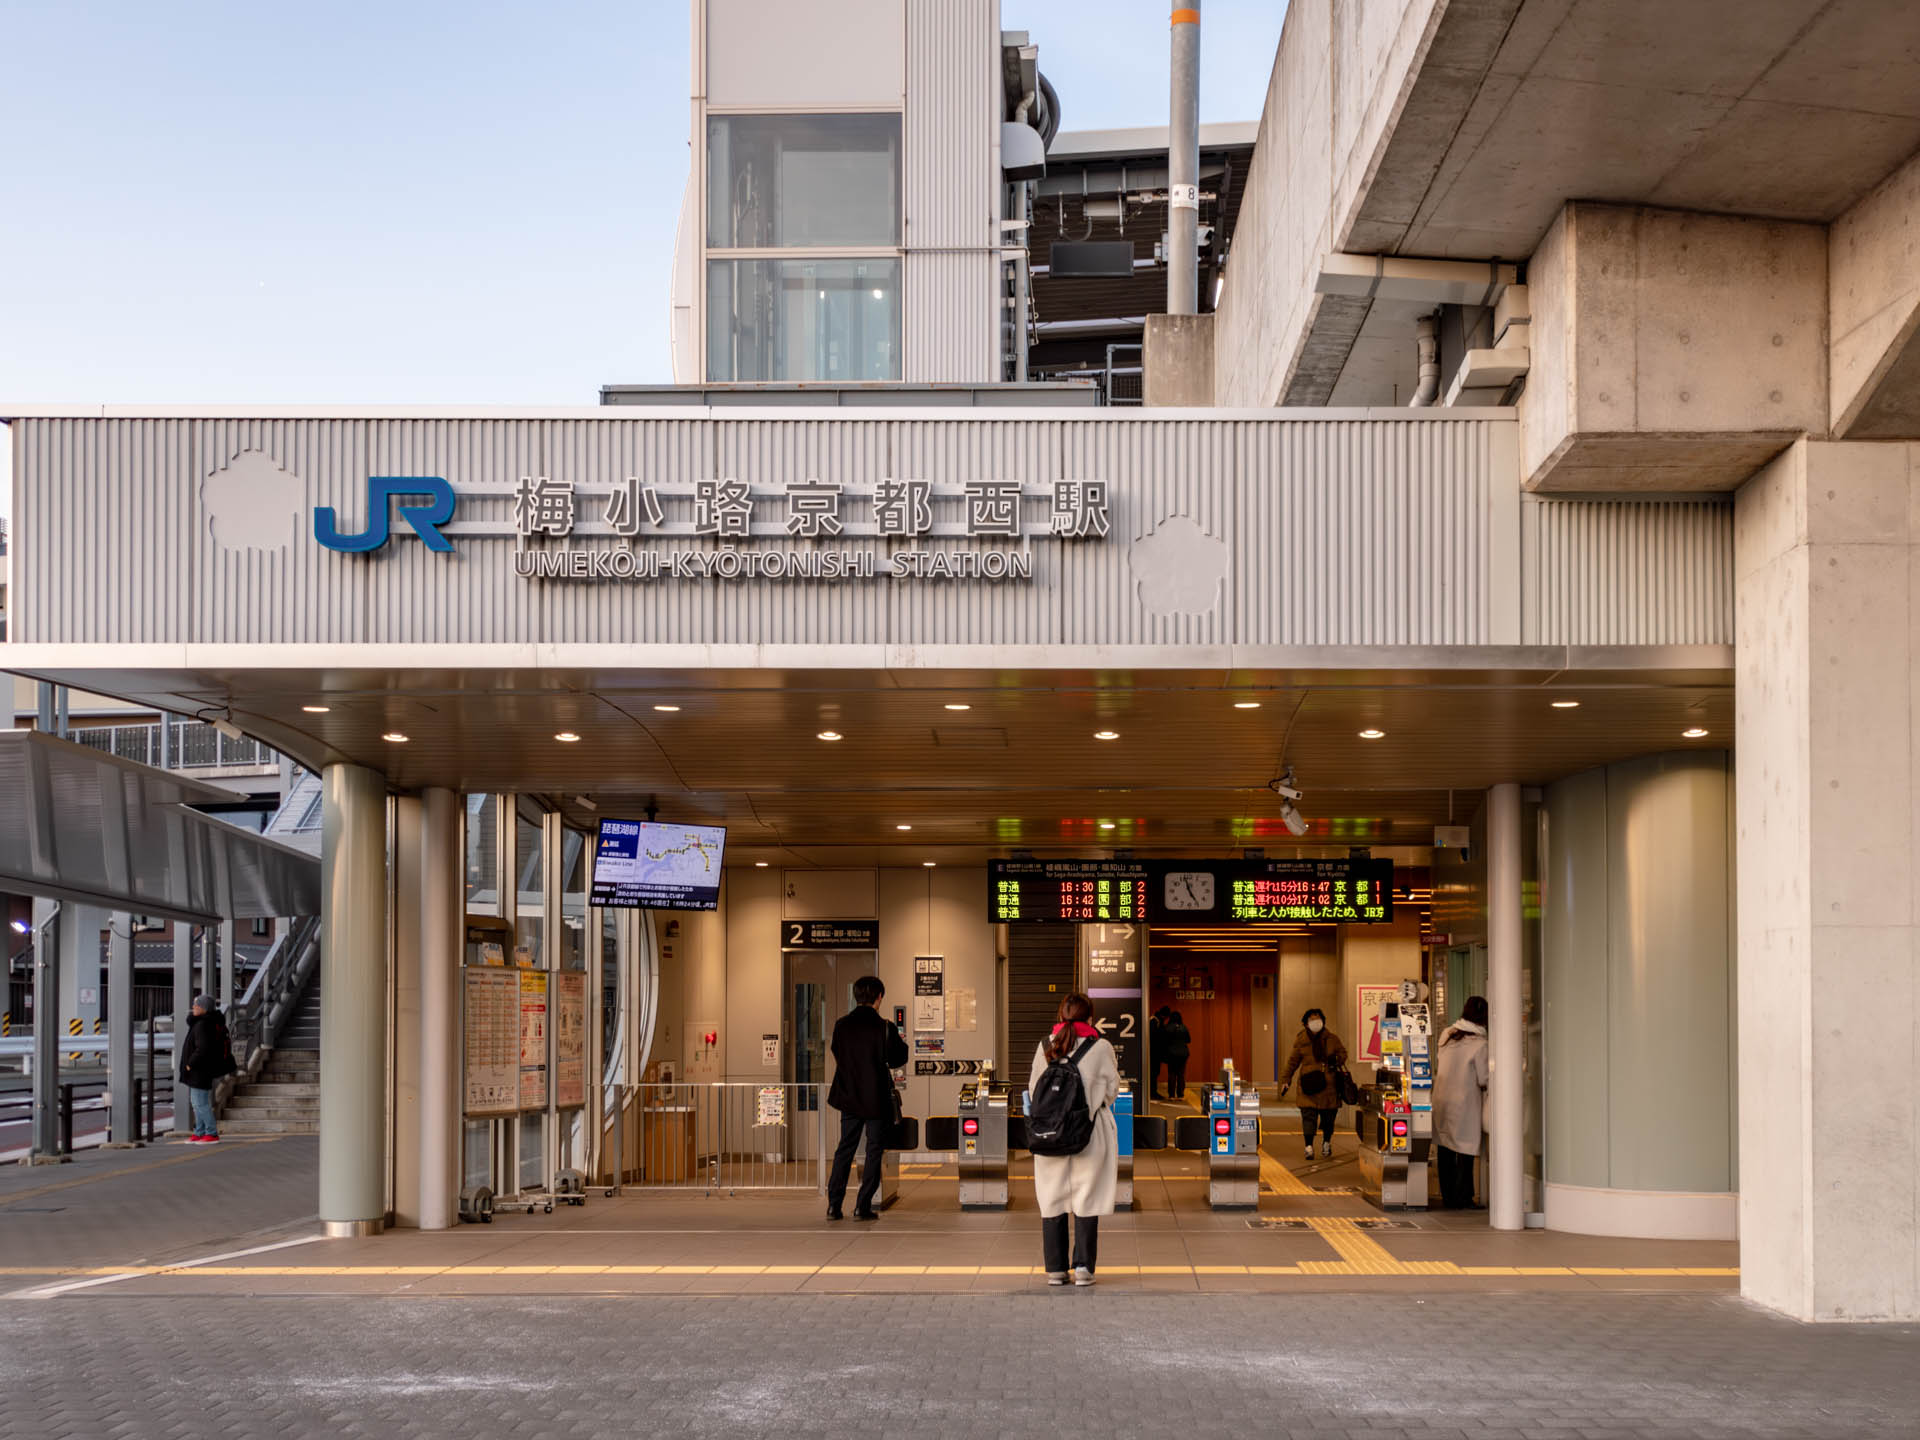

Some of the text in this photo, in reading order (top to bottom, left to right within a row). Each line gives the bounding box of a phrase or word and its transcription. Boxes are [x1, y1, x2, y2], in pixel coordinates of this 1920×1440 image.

[1188, 187, 1195, 200] 8
[314, 476, 456, 552] JR
[513, 475, 1110, 537] 梅小路京都西駅
[513, 544, 1032, 578] UMEKŌJI-KYŌTONISHI STATION
[998, 881, 1020, 893] 普通
[1137, 883, 1145, 892] 2
[998, 894, 1020, 905] 普通
[1137, 896, 1145, 904] 2
[998, 906, 1020, 918] 普通
[1137, 908, 1145, 917] 2
[790, 924, 804, 944] 2
[1095, 924, 1106, 943] 1
[1363, 991, 1395, 1006] 京都
[1120, 1013, 1135, 1038] 2
